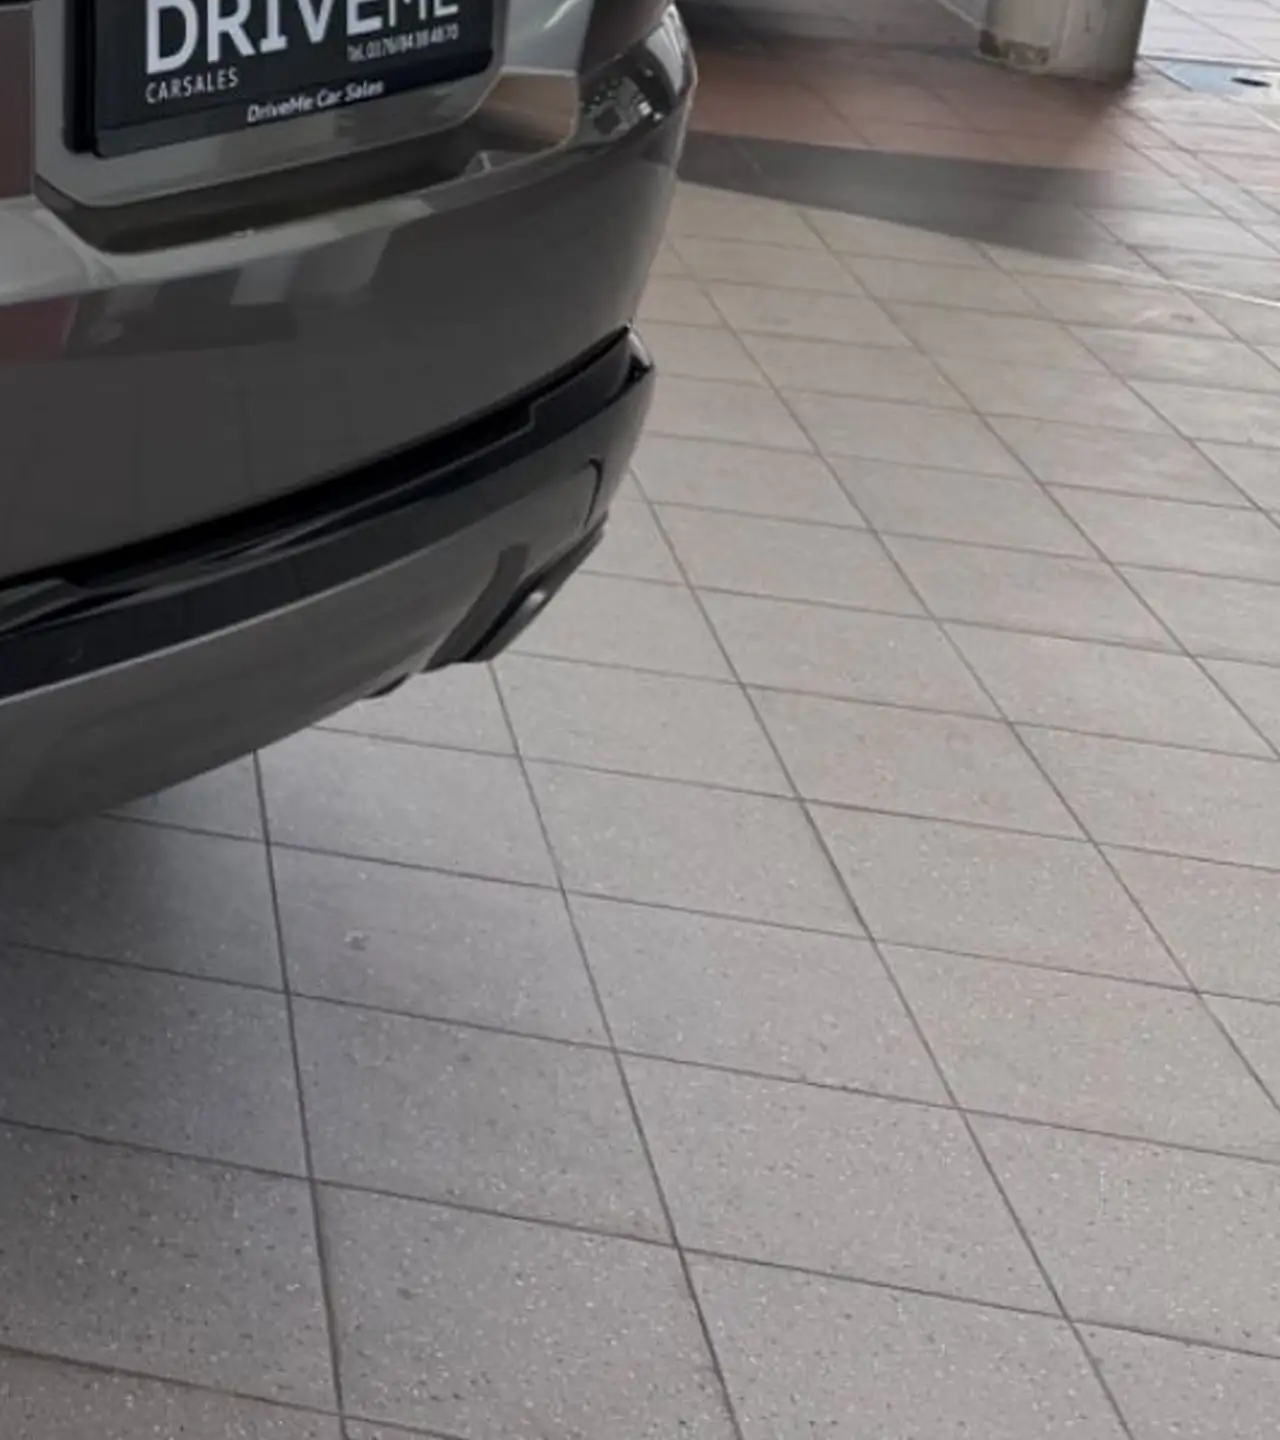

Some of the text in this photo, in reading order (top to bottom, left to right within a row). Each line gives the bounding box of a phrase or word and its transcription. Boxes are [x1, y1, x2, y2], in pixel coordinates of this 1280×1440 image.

[145, 66, 239, 104] CARSALES
[316, 86, 343, 109] Car
[343, 79, 385, 103] Sales
